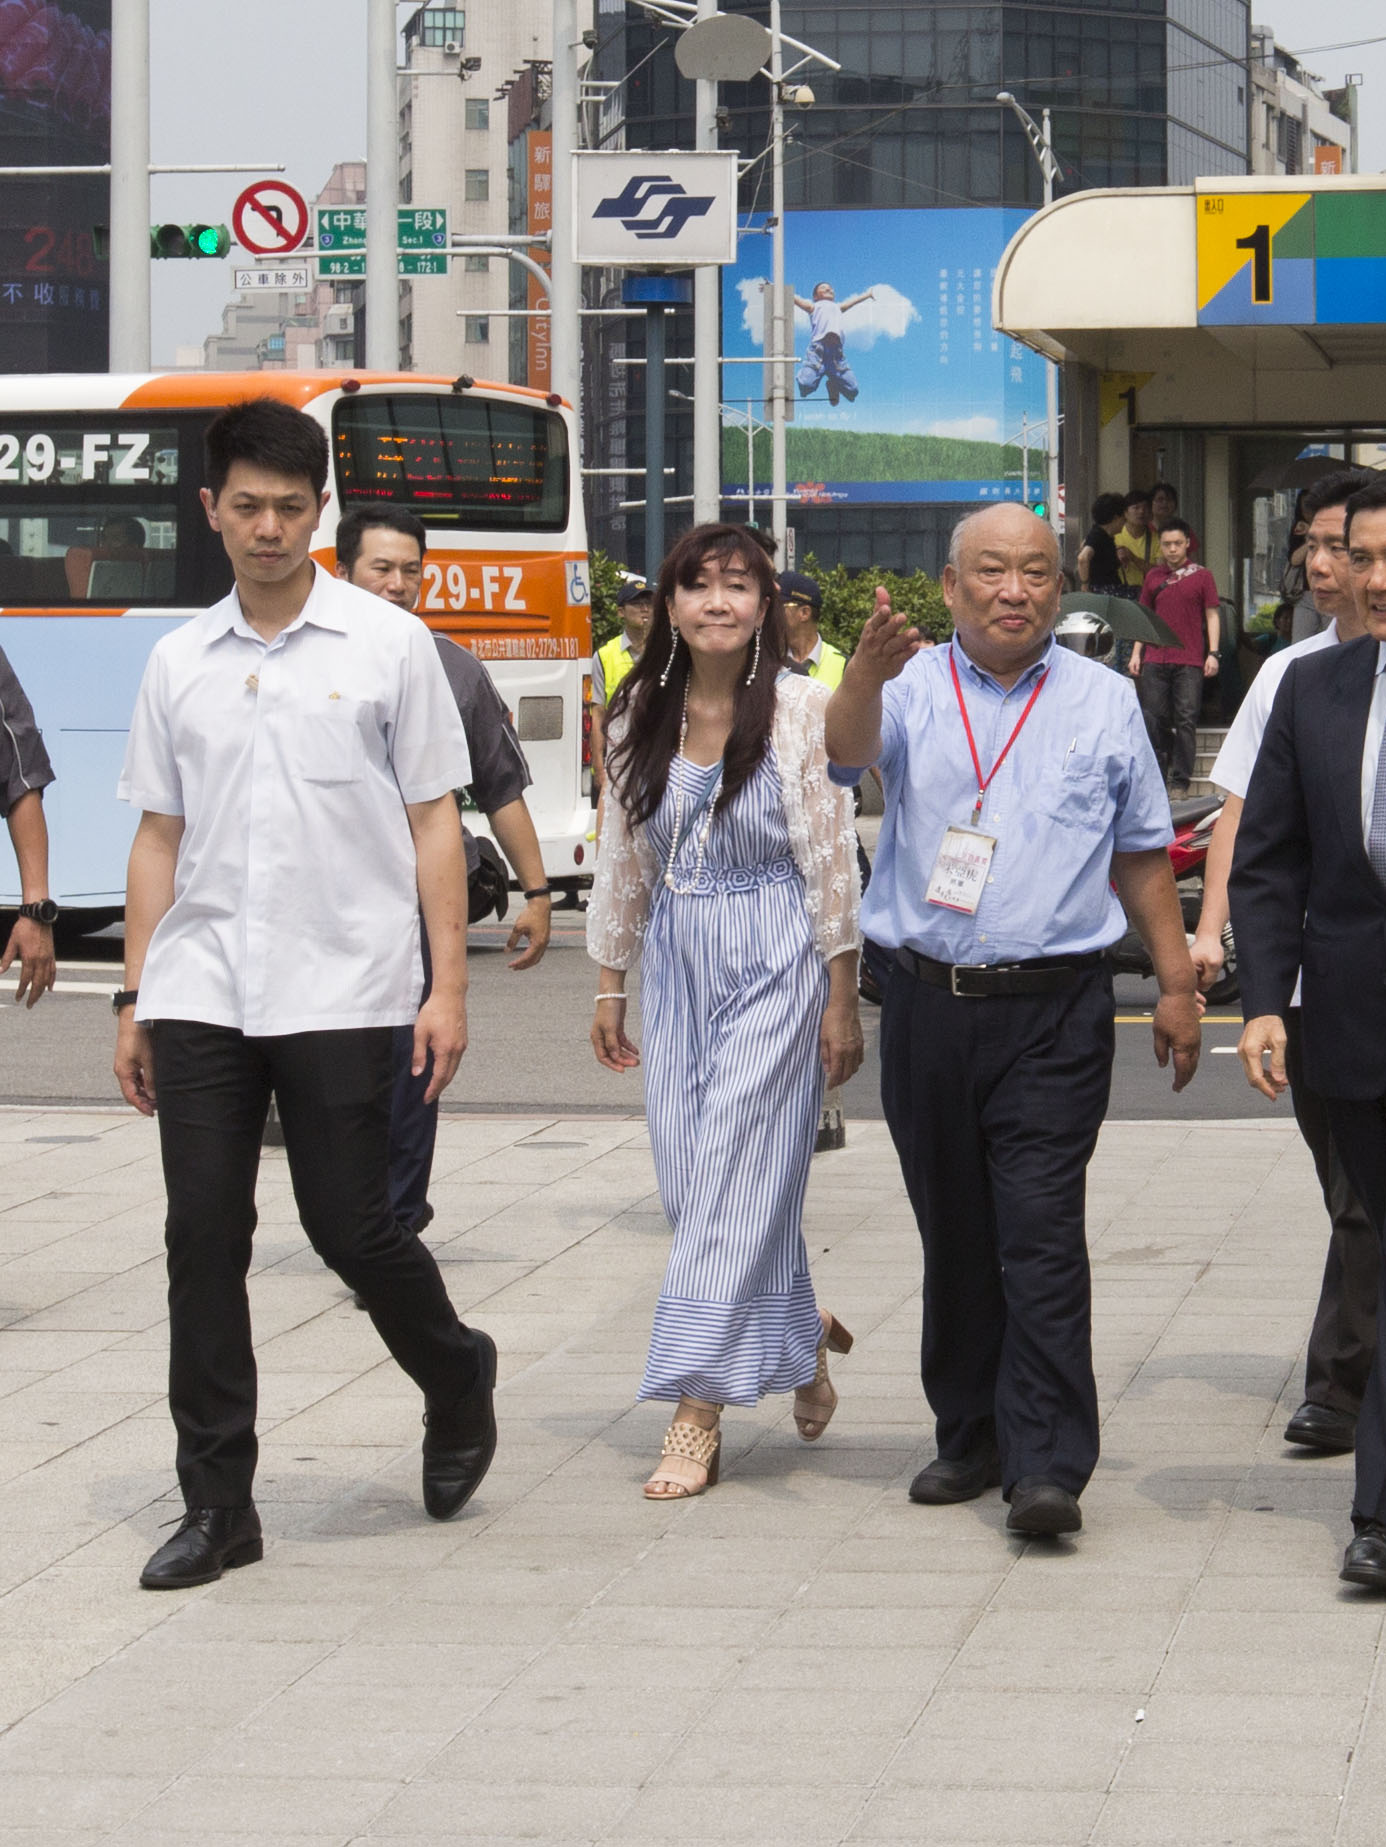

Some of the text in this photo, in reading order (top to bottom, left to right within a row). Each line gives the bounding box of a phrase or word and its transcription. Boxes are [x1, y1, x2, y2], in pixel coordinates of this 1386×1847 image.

[333, 212, 433, 231] 中華一段
[239, 272, 305, 286] 公車除外
[1235, 225, 1271, 303] 1
[413, 564, 526, 612] 29-FZ
